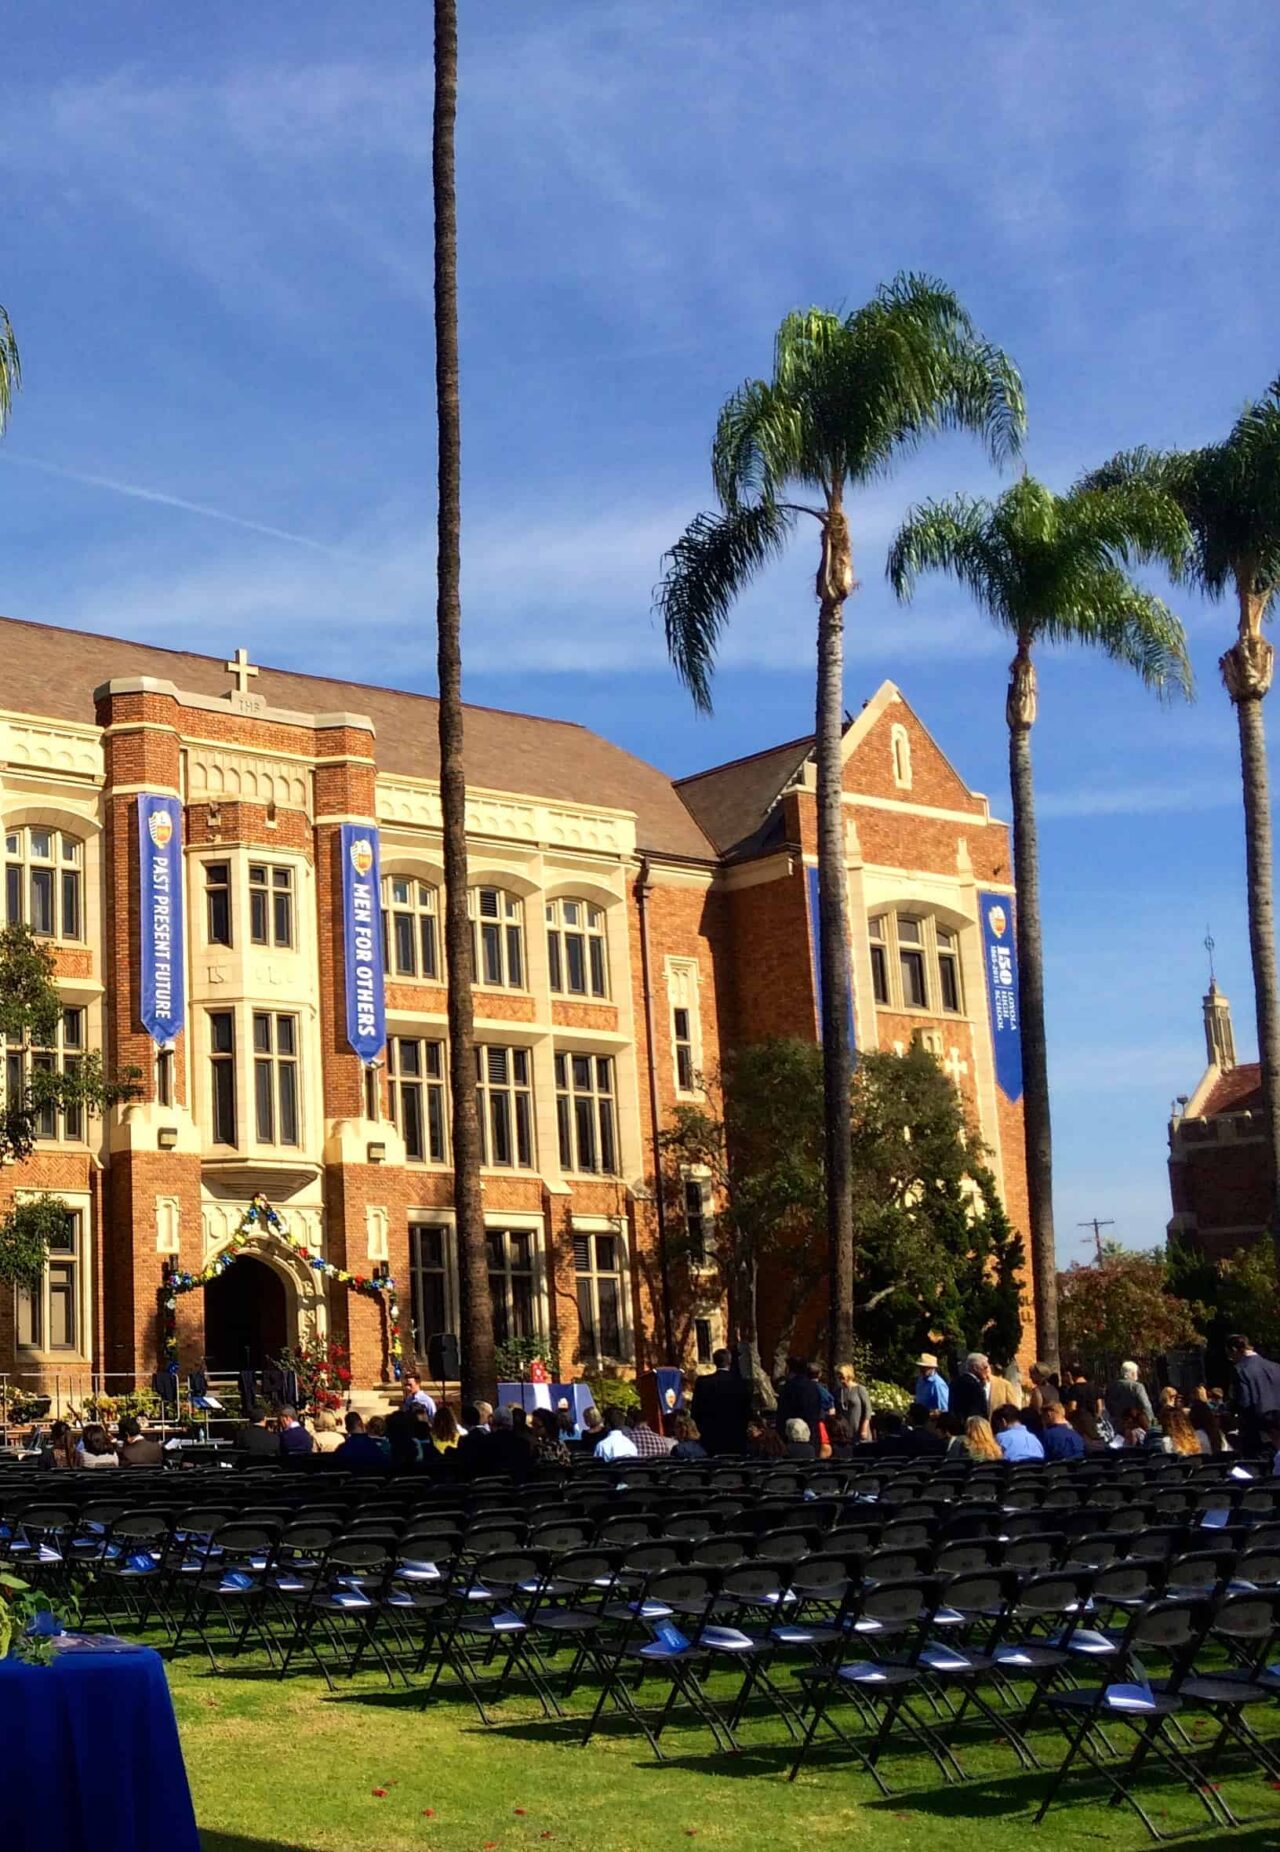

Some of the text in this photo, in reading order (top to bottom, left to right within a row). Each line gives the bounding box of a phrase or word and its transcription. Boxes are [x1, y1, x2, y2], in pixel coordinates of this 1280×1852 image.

[153, 856, 171, 1020] PAST PRESENT FUTURE
[353, 883, 375, 1037] MEN FOR OTHERS
[997, 945, 1013, 985] 150
[994, 989, 1005, 1031] SCHOOL
[1001, 990, 1010, 1019] HIGH
[1007, 991, 1017, 1031] LOYOLA
